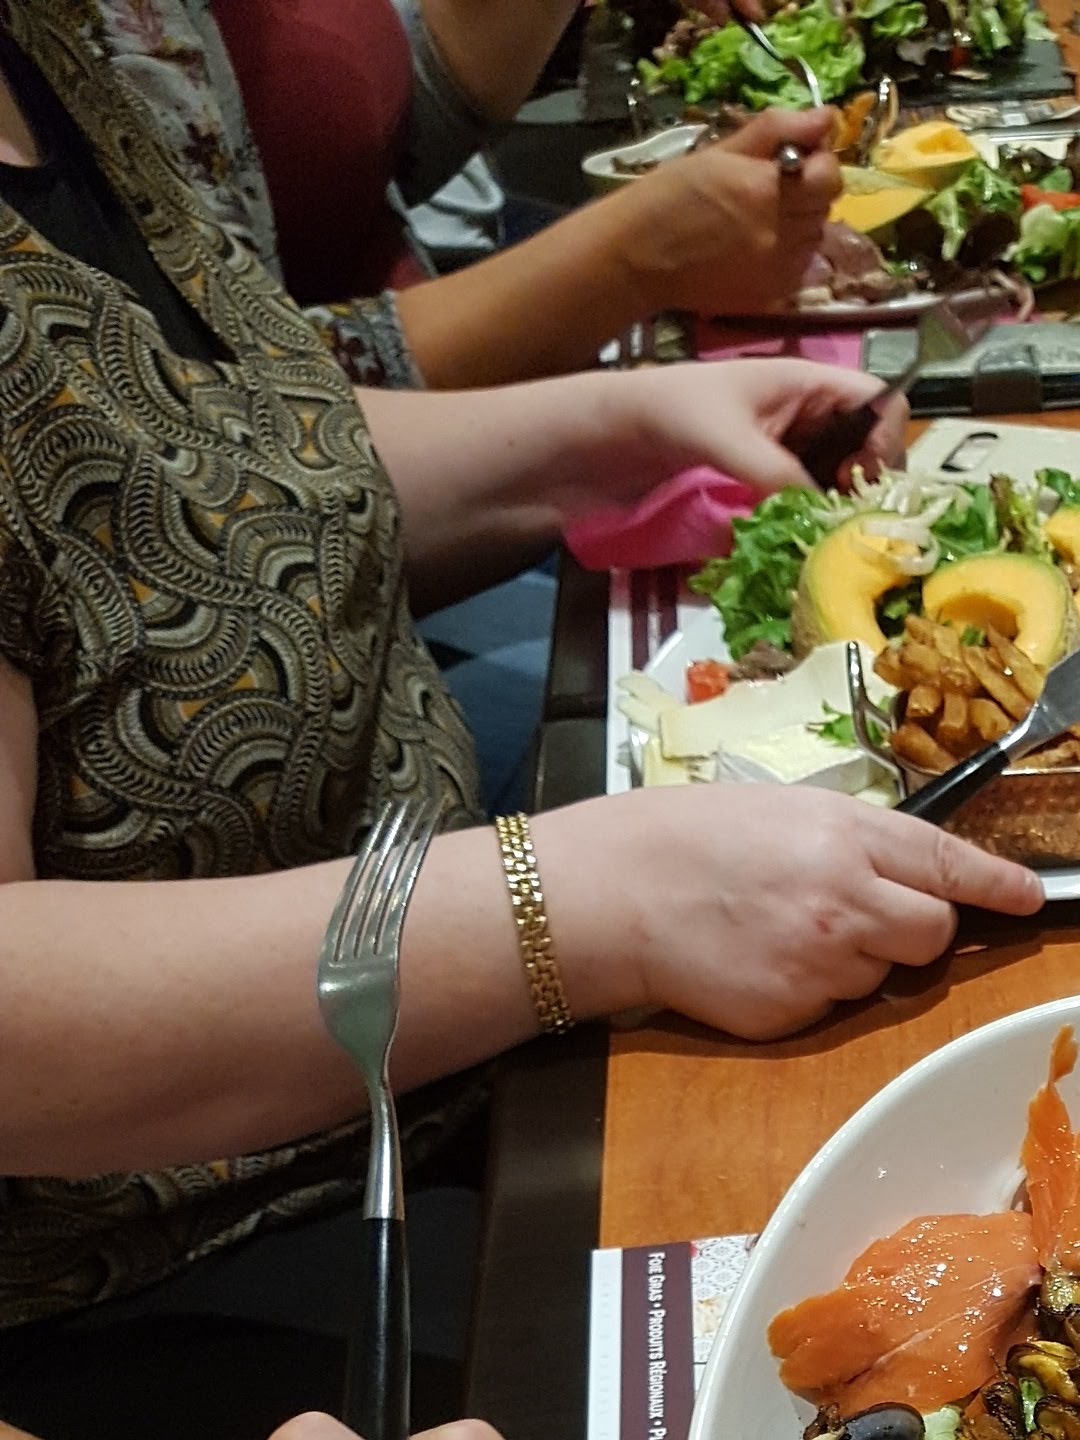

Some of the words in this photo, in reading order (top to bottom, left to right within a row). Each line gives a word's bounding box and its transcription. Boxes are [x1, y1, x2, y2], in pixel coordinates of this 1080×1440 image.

[648, 1252, 665, 1274] FOIE
[648, 1275, 666, 1300] GRAS
[648, 1309, 667, 1360] PRODUITS
